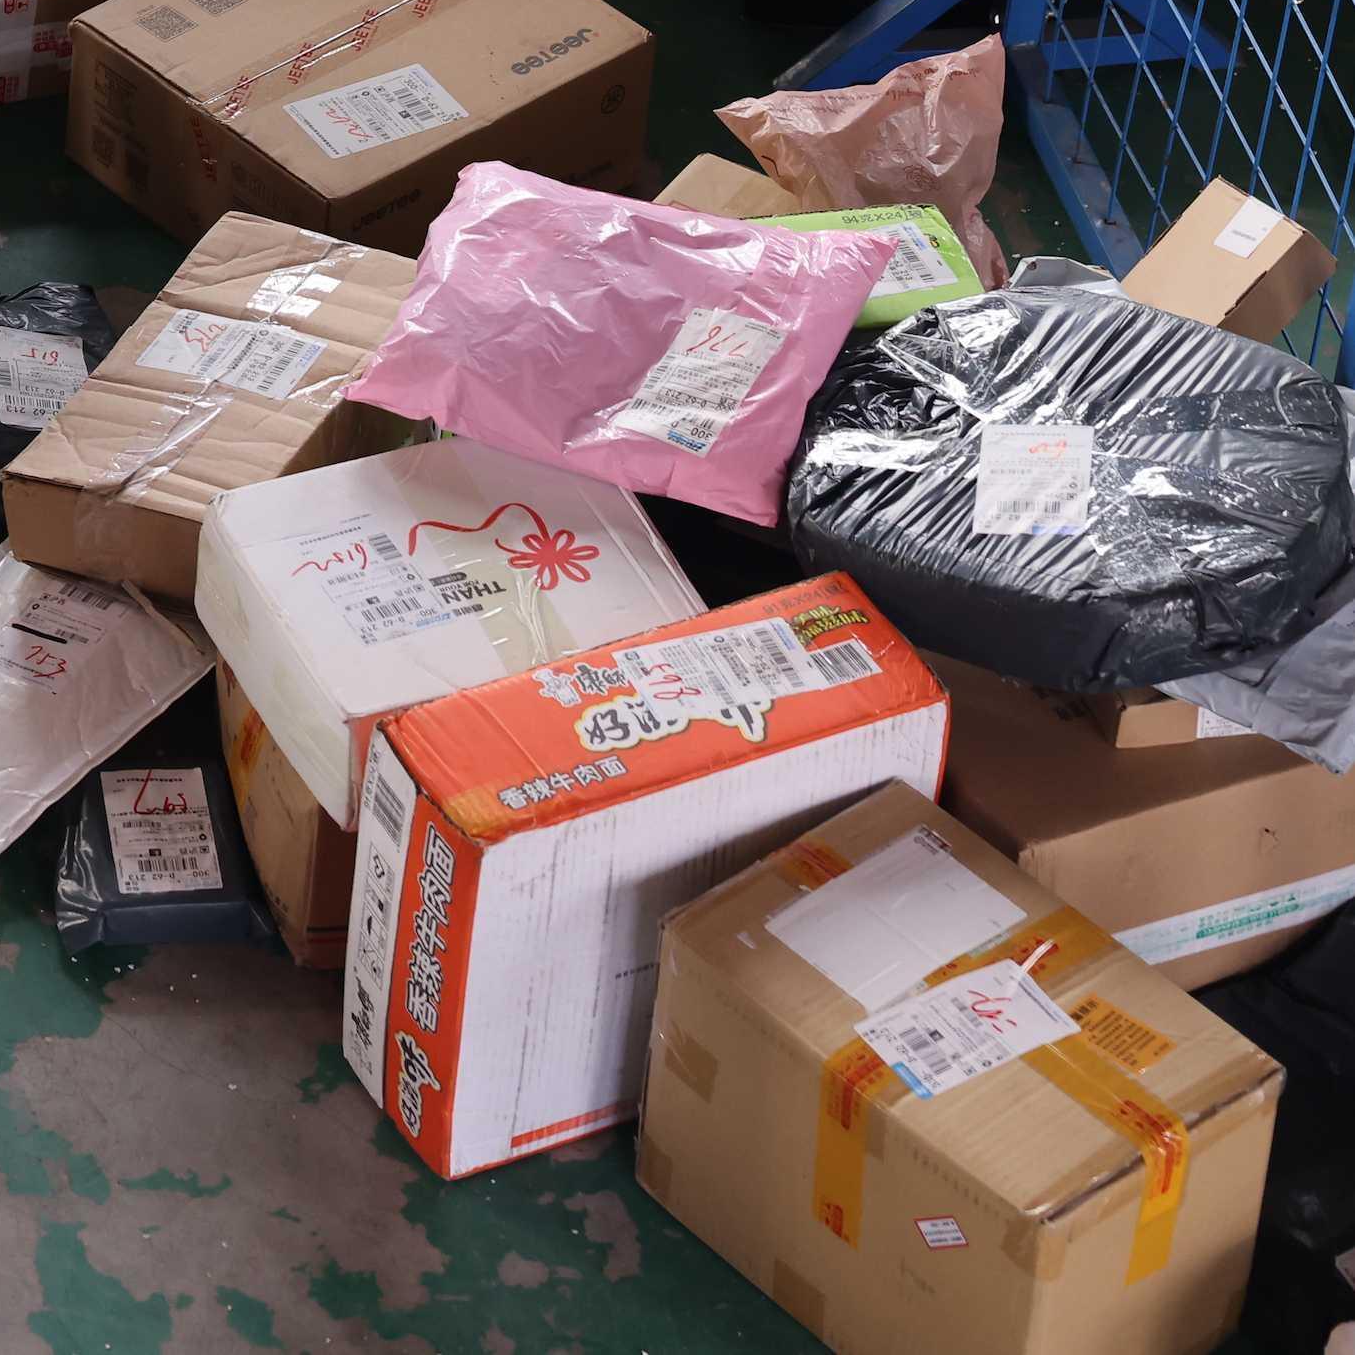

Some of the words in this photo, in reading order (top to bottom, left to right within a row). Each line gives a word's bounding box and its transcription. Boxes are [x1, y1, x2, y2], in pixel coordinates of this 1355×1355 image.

[352, 7, 380, 52] JEETEE
[286, 41, 315, 85] JEETEE
[498, 754, 628, 810] 香辣牛肉面
[403, 820, 457, 1035] 香辣牛肉面
